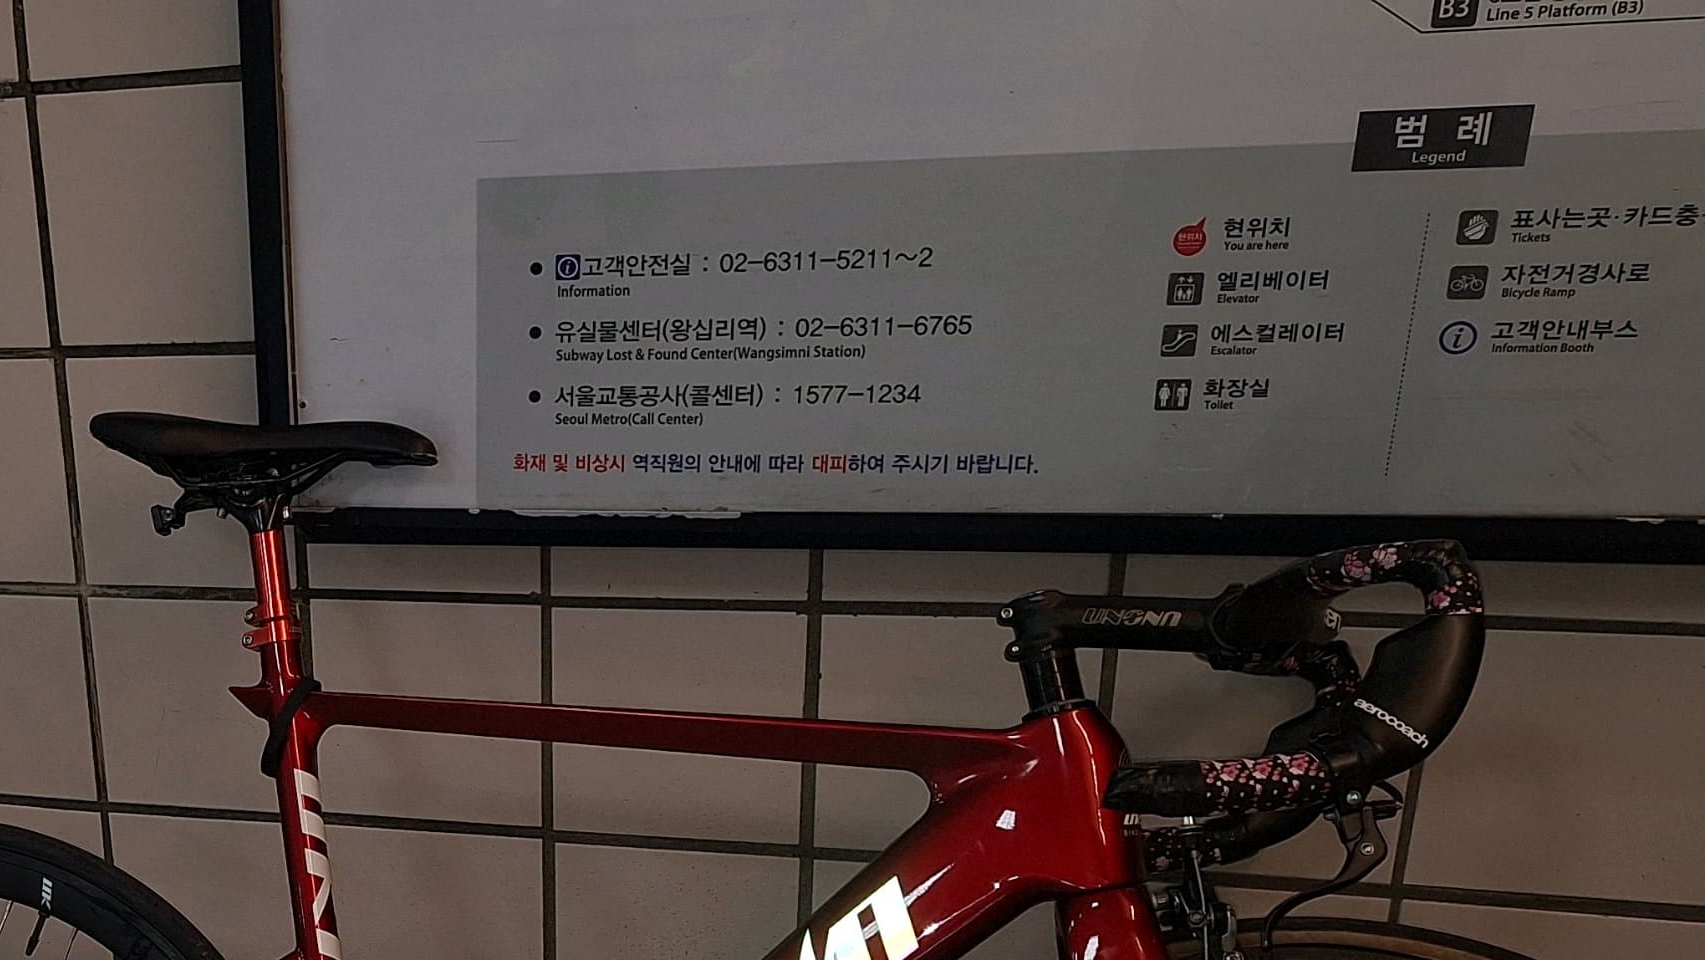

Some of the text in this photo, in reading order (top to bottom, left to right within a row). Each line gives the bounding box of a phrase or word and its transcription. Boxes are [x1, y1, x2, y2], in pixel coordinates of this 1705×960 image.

[1487, 0, 1643, 21] Line 5 Platform (B3)
[1412, 150, 1466, 165] Legend
[1511, 204, 1705, 229] 표사는곳·카드충
[1224, 217, 1290, 241] 현위치
[1512, 232, 1550, 242] Tickets
[1224, 241, 1246, 250] You
[1268, 240, 1289, 250] here
[580, 253, 690, 277] 고객안전실
[1502, 263, 1649, 285] 자전거경사로
[1218, 270, 1329, 291] 엘리베이터
[558, 284, 630, 297] Information
[1217, 290, 1259, 303] Elevator
[1502, 287, 1575, 299] Bicycle Ramp
[555, 317, 766, 343] 유실물센터(왕십리역)
[796, 315, 972, 337] 02-6311-6765
[1211, 323, 1344, 343] 에스컬레이터
[1491, 320, 1638, 340] 고객안내부스
[556, 349, 603, 364] Subway
[607, 349, 632, 360] Lost
[648, 348, 687, 360] Found
[814, 345, 865, 358] Station)
[1211, 342, 1257, 355] Escalator
[1492, 343, 1594, 352] Information Booth
[555, 384, 763, 407] 서울교통공사(콜센터)
[795, 384, 921, 404] 1577-1234
[1203, 379, 1269, 398] 화장실
[1205, 397, 1233, 409] Toilet
[556, 413, 703, 426] Seoul Metro(Call Center)
[514, 454, 1038, 474] 화재 및 비상시 역직원의 안내에 따라 대피하여 주시기 바랍니다.
[1354, 697, 1430, 749] aerocoach
